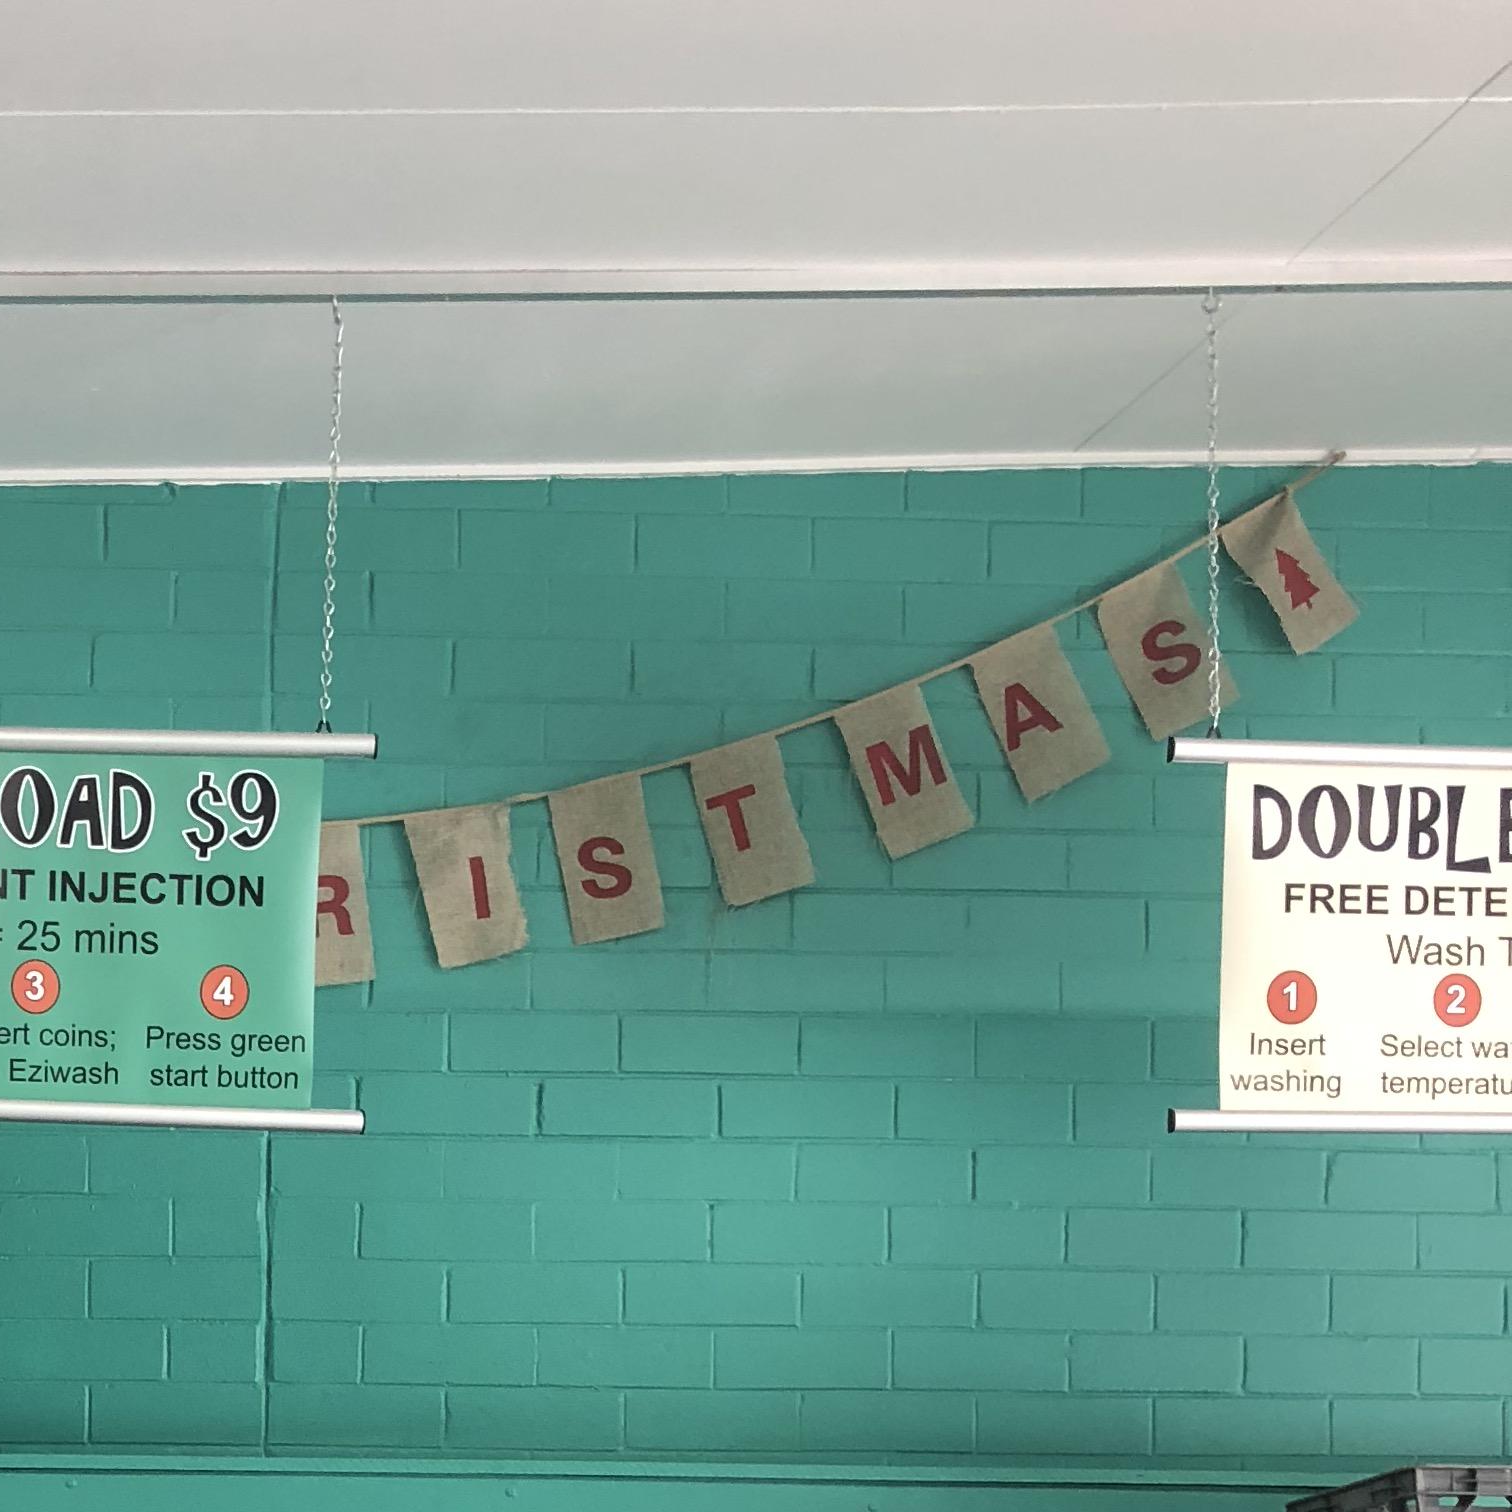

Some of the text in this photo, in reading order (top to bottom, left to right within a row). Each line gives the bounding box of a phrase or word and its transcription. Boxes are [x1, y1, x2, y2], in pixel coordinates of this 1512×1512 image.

[182, 769, 279, 862] $9
[49, 870, 265, 908] INJECTION
[1284, 883, 1389, 914] FREE
[16, 921, 62, 954] 25
[74, 923, 160, 957] mins
[1387, 934, 1485, 966] Wash
[24, 972, 45, 1001] 3
[211, 977, 234, 1007] 4
[1282, 983, 1299, 1011] 1
[1447, 986, 1465, 1014] 2
[37, 1023, 117, 1054] coins;
[146, 1025, 306, 1062] Press green
[1250, 1033, 1326, 1056] Insert
[1381, 1035, 1462, 1058] Select
[9, 1058, 119, 1087] Eziwash
[150, 1063, 299, 1091] start button
[1230, 1071, 1341, 1098] washing
